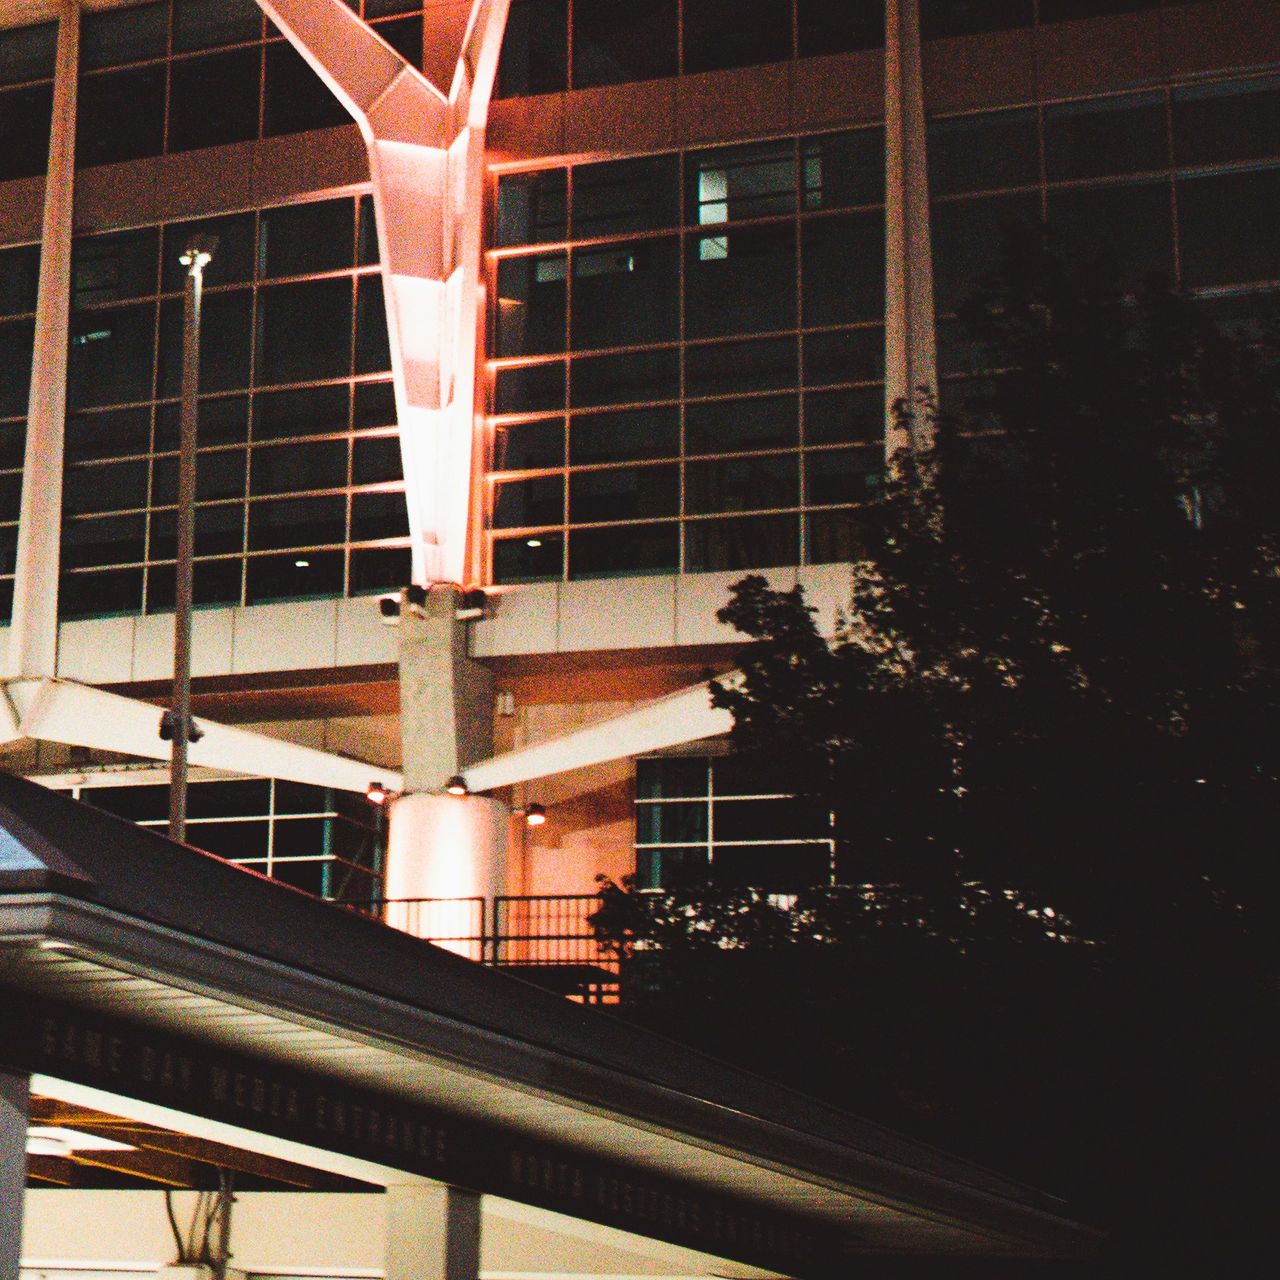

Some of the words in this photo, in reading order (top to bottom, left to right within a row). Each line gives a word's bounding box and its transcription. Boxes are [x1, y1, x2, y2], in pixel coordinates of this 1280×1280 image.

[44, 1018, 122, 1073] GAME
[142, 1045, 193, 1091] DAY
[211, 1065, 300, 1121] MEDIA
[317, 1094, 446, 1163] ENTRANCE
